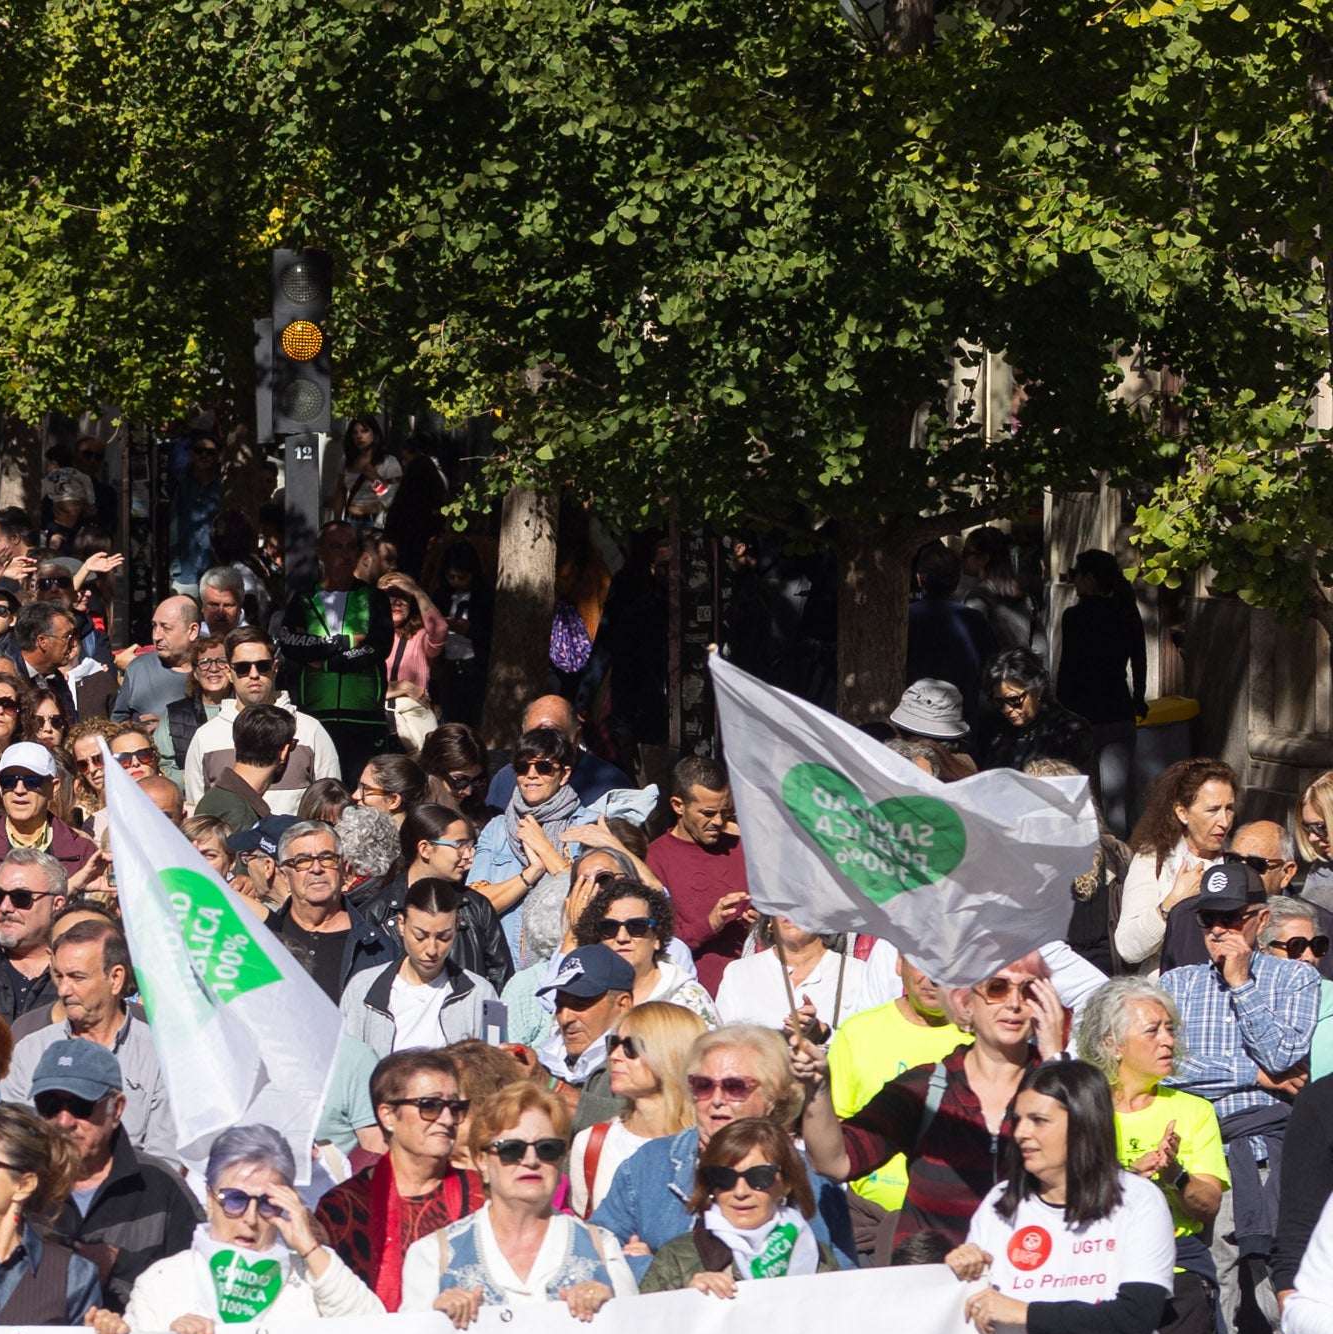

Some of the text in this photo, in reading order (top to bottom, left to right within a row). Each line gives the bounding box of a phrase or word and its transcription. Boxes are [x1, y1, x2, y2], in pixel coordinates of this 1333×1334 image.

[210, 933, 250, 994] 100%
[1073, 1239, 1103, 1254] UGT
[1011, 1247, 1042, 1266] UGT
[1013, 1273, 1107, 1290] Lo Primero
[220, 1298, 257, 1317] 100%
